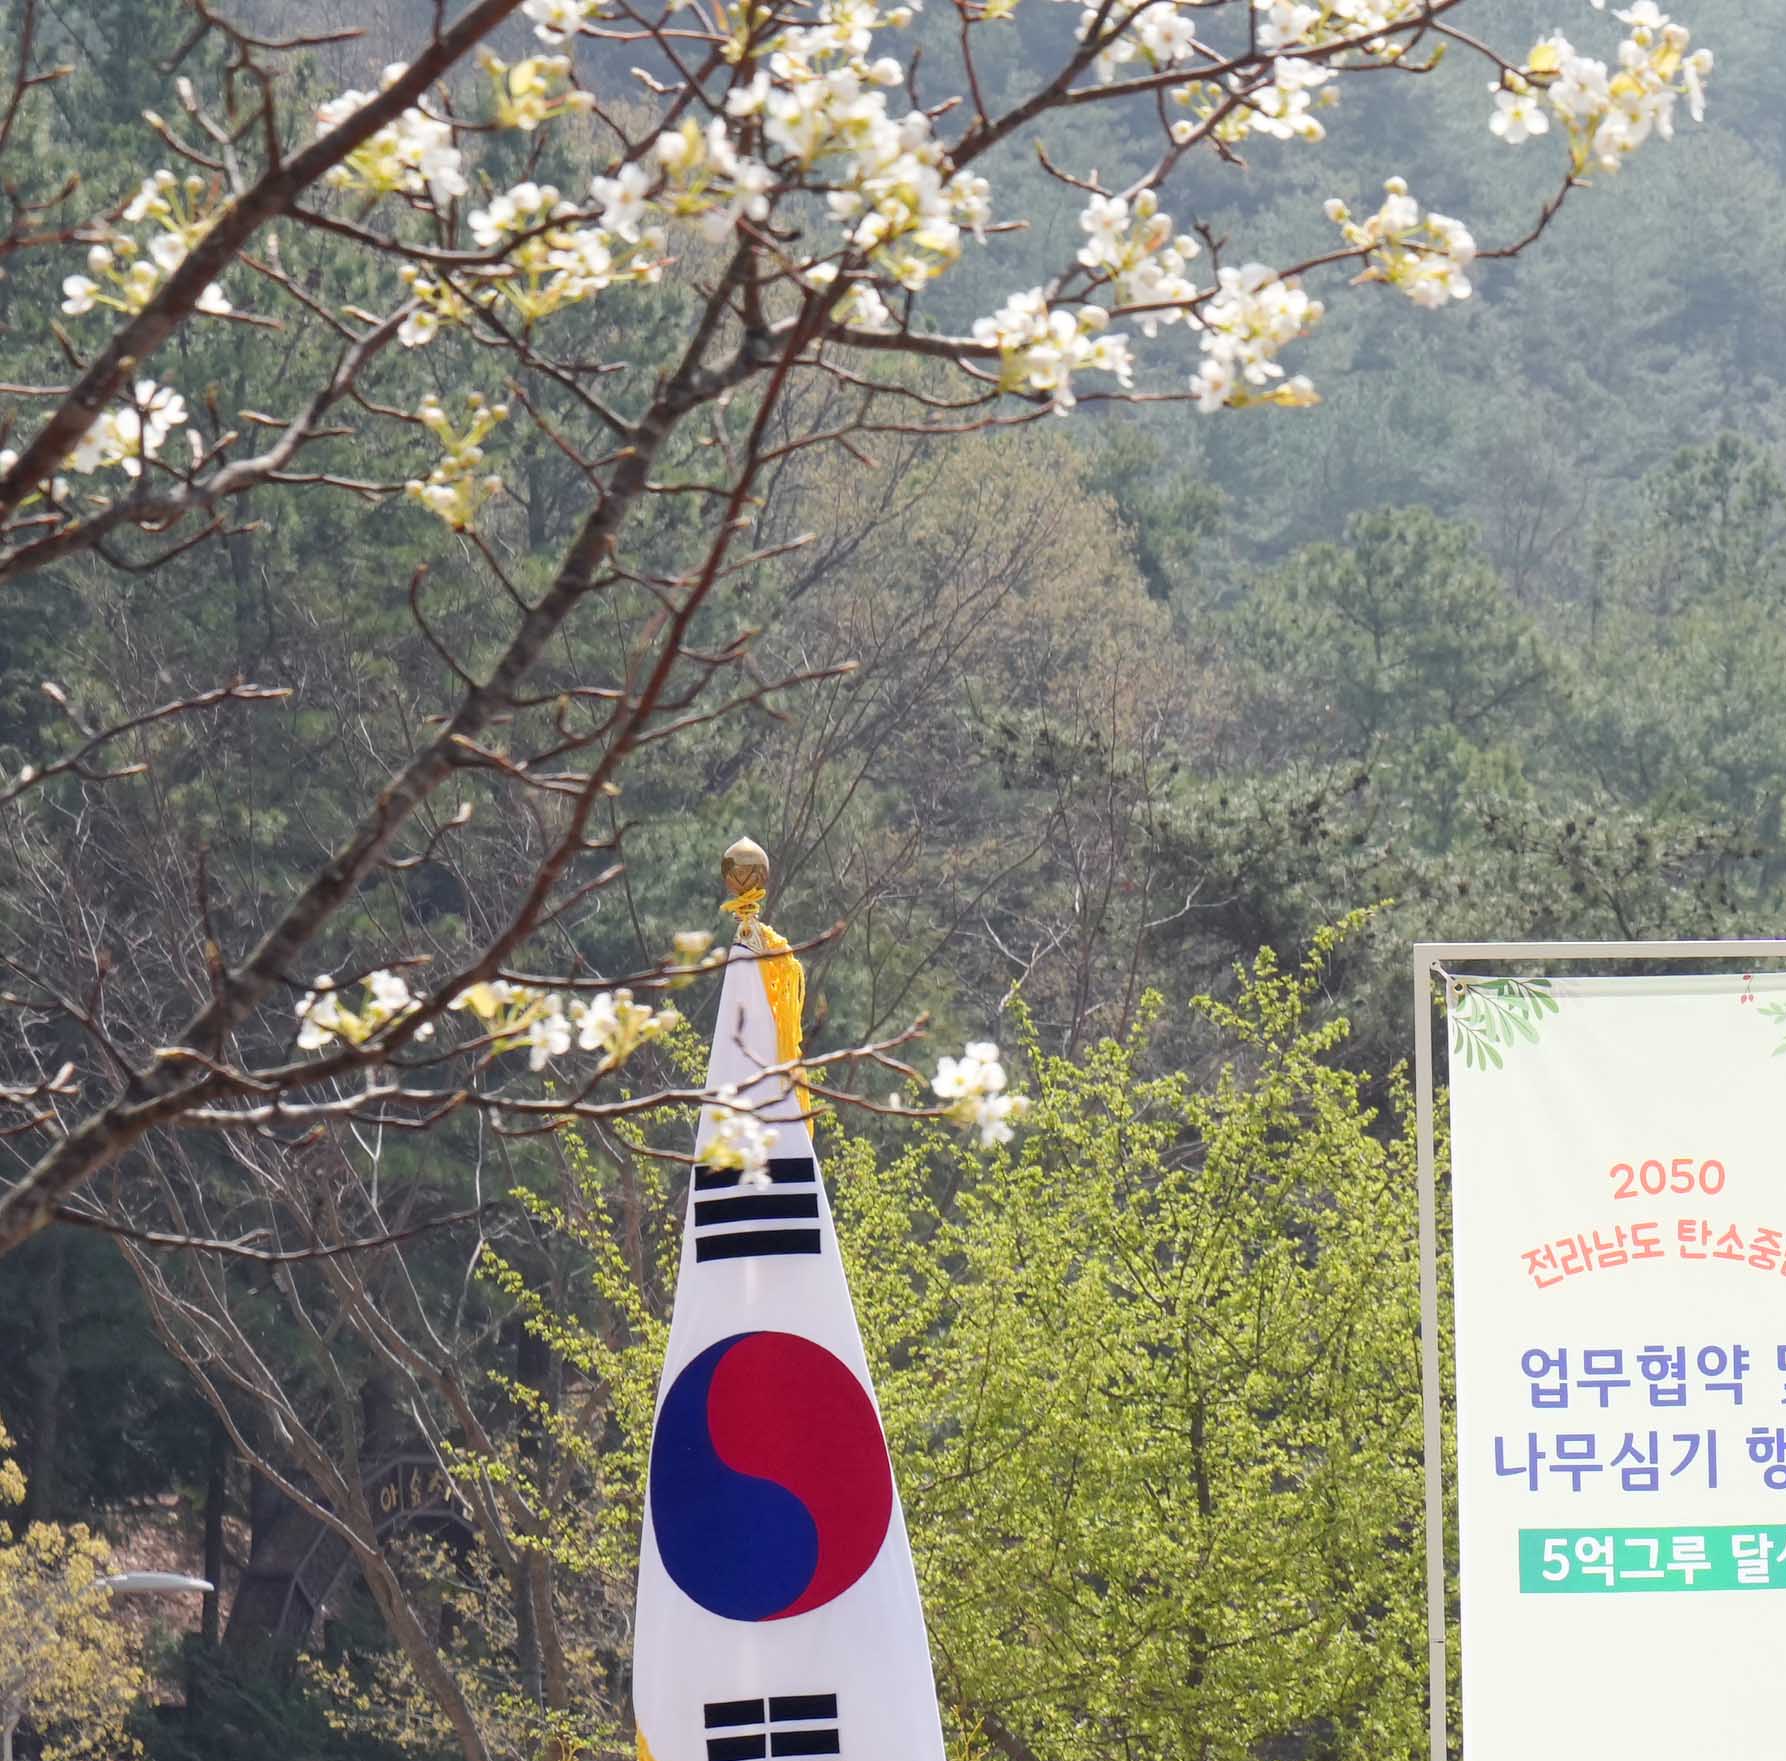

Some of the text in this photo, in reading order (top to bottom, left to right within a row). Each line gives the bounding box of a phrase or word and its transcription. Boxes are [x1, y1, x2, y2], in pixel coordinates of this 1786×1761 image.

[1609, 1158, 1726, 1200] 2050
[1521, 1221, 1665, 1289] 전라남도
[1521, 1344, 1751, 1409] 업무협약
[1494, 1429, 1718, 1493] 나무심기
[1542, 1535, 1713, 1587] 5억그루
